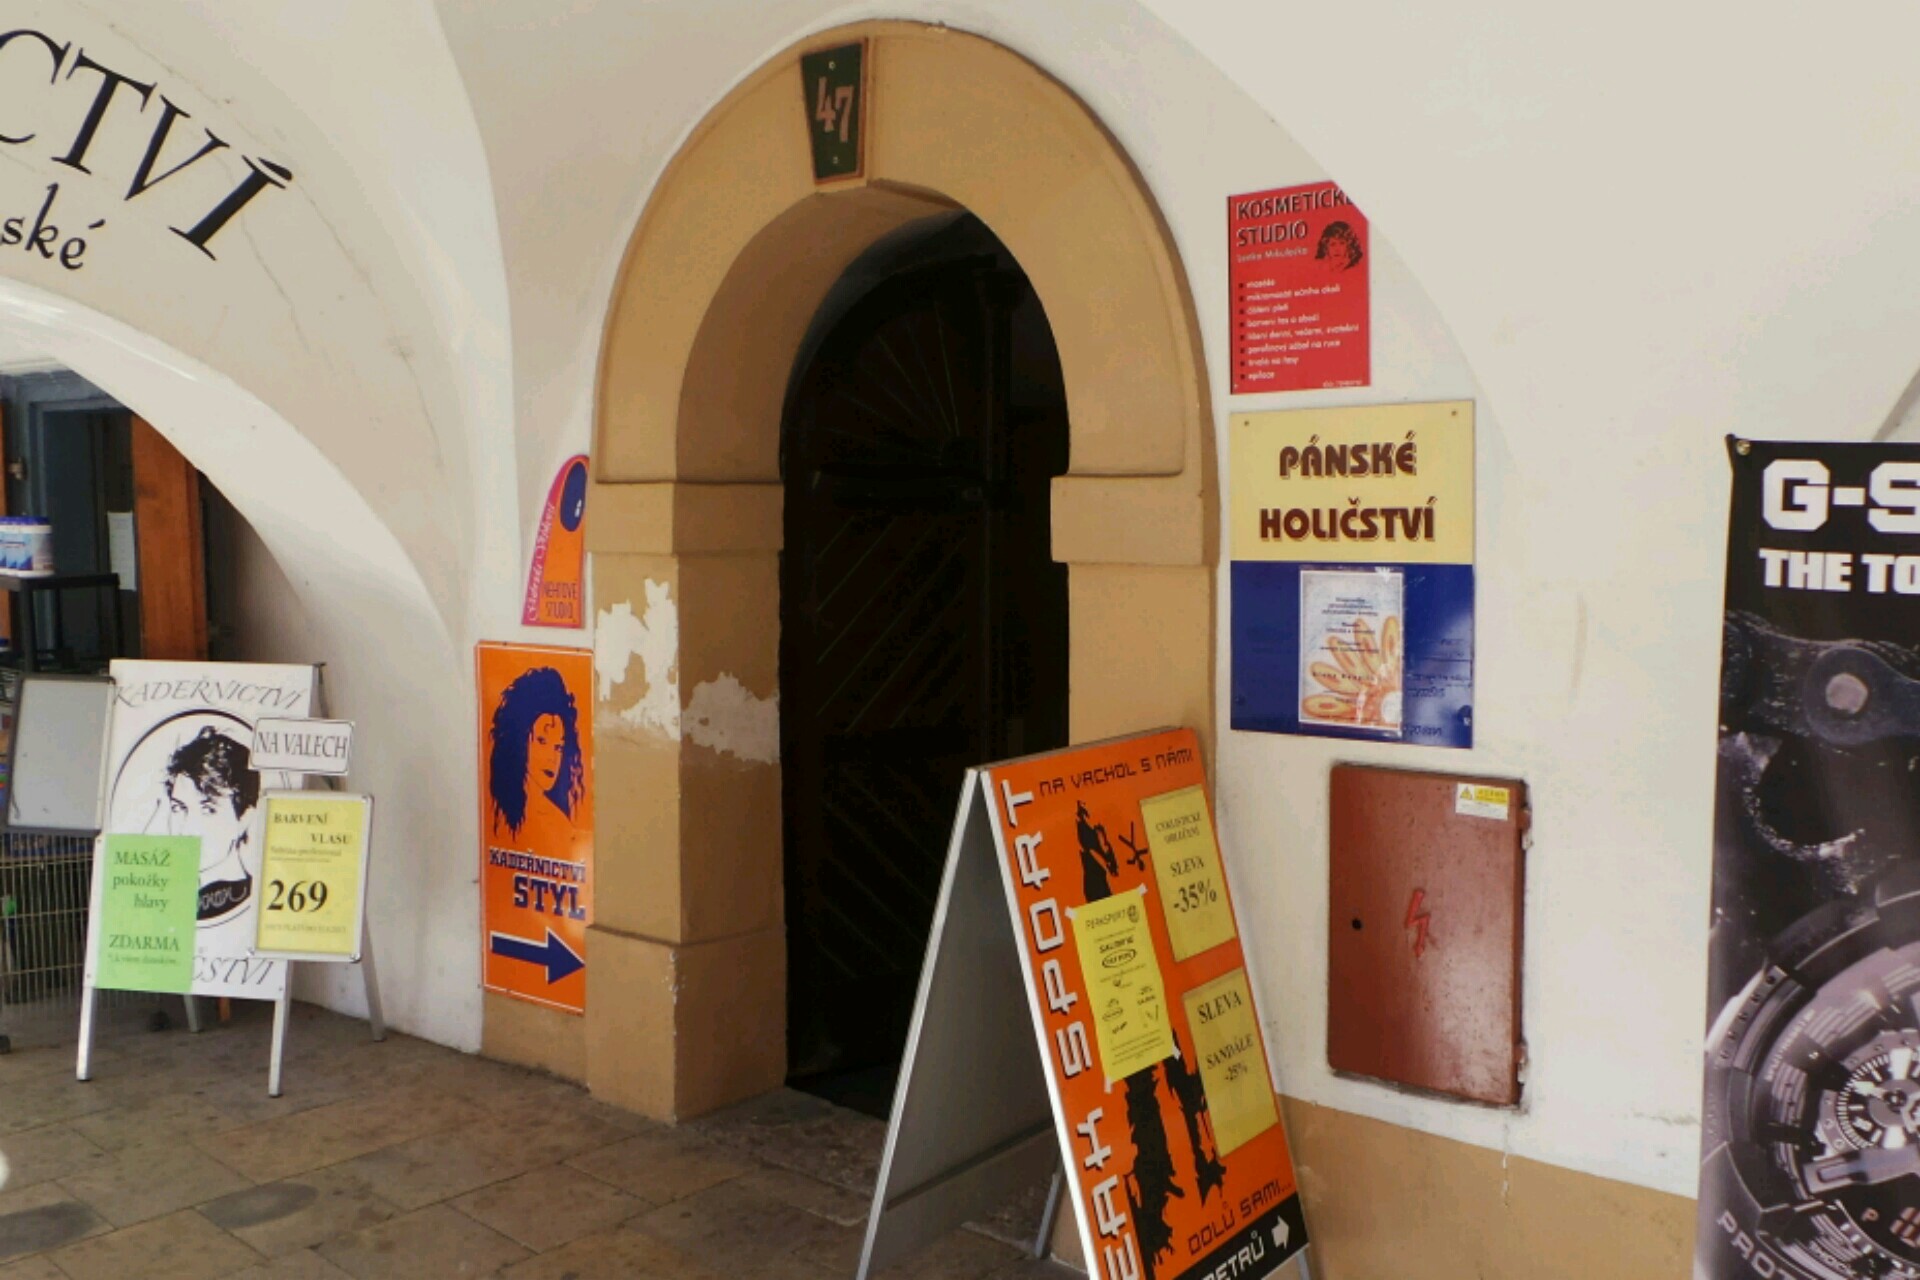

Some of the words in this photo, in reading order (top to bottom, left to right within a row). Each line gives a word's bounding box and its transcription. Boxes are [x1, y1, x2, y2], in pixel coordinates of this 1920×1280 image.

[815, 76, 855, 143] 47
[0, 28, 292, 261] CTVÍ
[0, 183, 106, 270] ské
[1236, 219, 1309, 248] STUDIO
[1279, 430, 1417, 479] PÁNSKÉ
[1259, 495, 1438, 541] HOLIČSTVÍ
[1758, 548, 1852, 592] THE
[256, 731, 280, 754] NA
[283, 732, 348, 760] VALECH
[1039, 777, 1066, 798] NA
[1070, 762, 1137, 789] VRCHOL
[1140, 757, 1152, 772] S
[273, 812, 329, 825] BARVENÍ
[113, 849, 171, 867] MASÁŽ
[489, 848, 586, 883] KADEŘNICTVÍ
[1169, 856, 1205, 878] SLEVA
[112, 872, 169, 892] pokožky
[267, 878, 329, 913] 269
[513, 872, 586, 921] STYL
[1173, 878, 1218, 914] -35%
[133, 892, 169, 912] hlavy
[109, 933, 180, 951] ZDARMA
[1001, 779, 1092, 1079] SPORT
[1197, 989, 1243, 1025] SLEVA
[1186, 1201, 1237, 1256] DOLŮ
